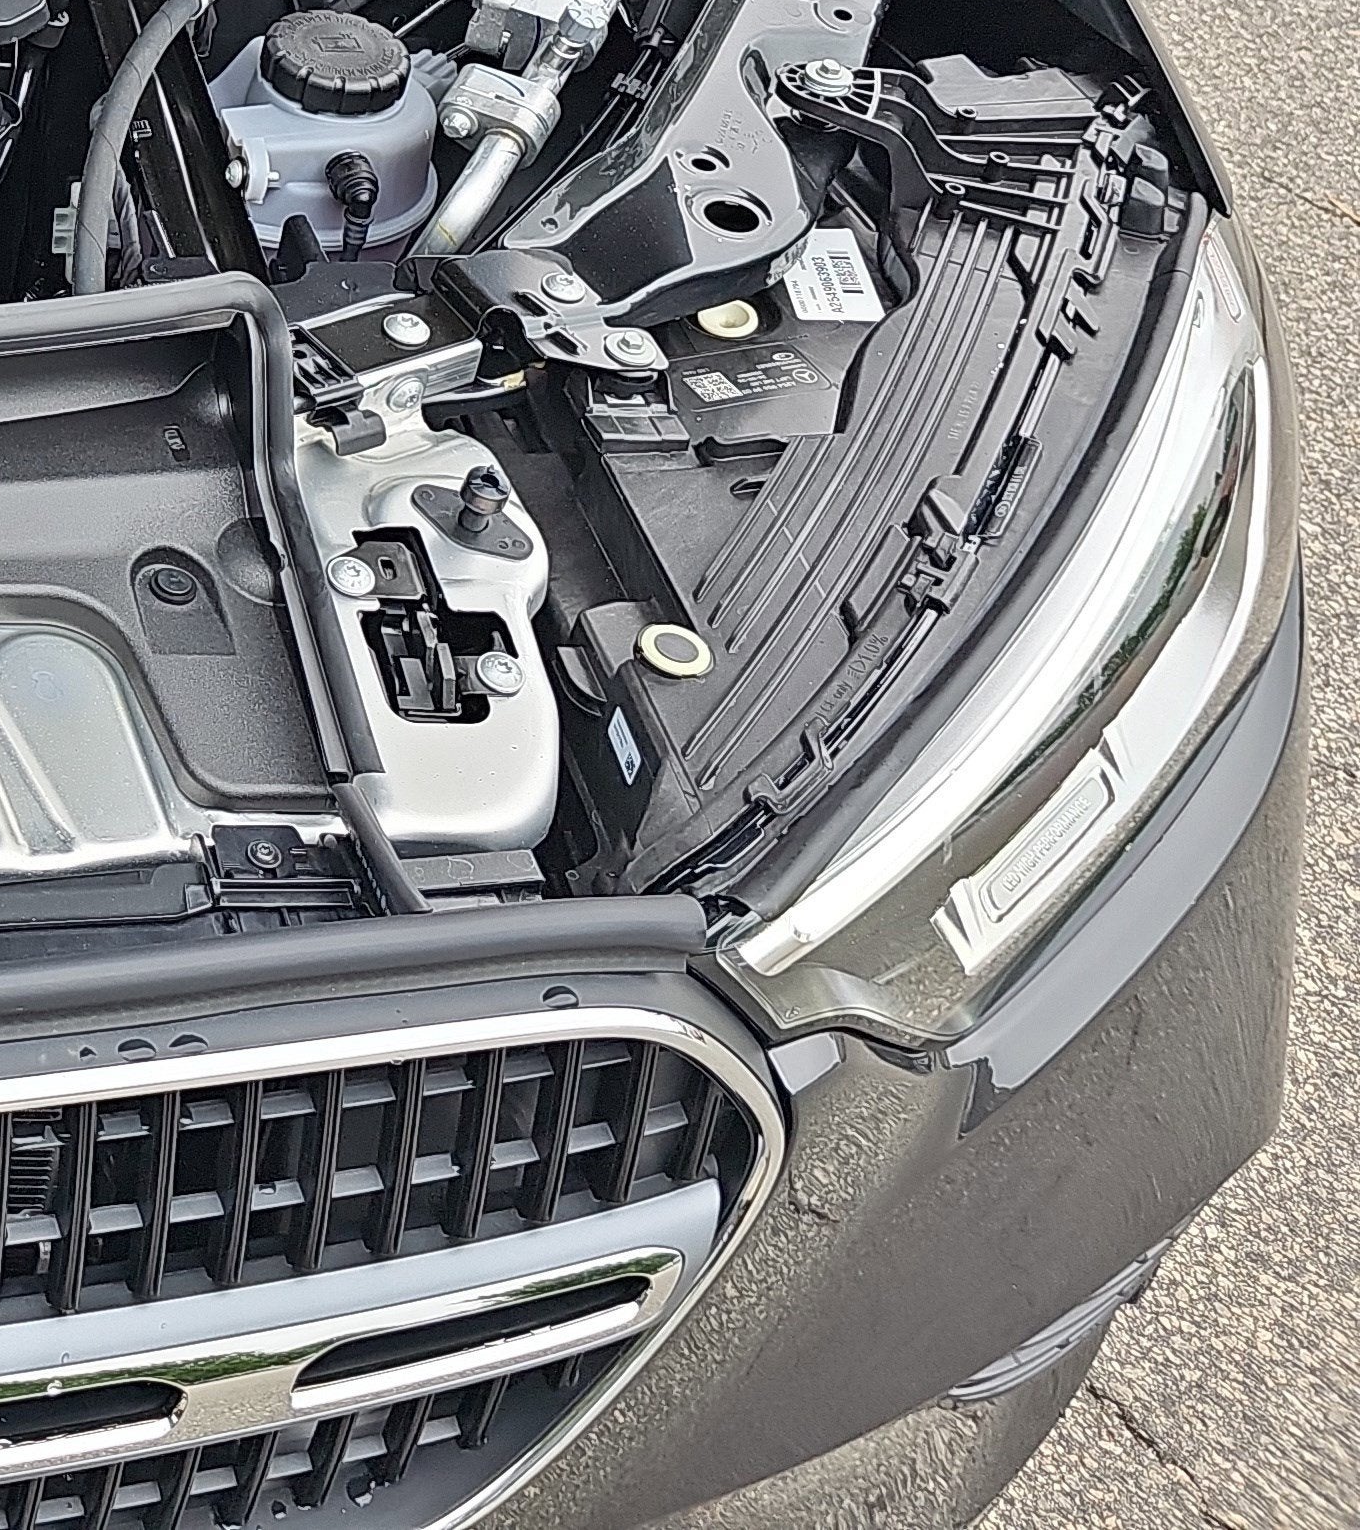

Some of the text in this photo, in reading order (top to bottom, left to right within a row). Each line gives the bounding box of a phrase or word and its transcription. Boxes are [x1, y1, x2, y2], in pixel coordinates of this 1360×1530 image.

[857, 633, 889, 662] 1.0%
[1001, 795, 1092, 892] LED HIGH PERFORMANCE
